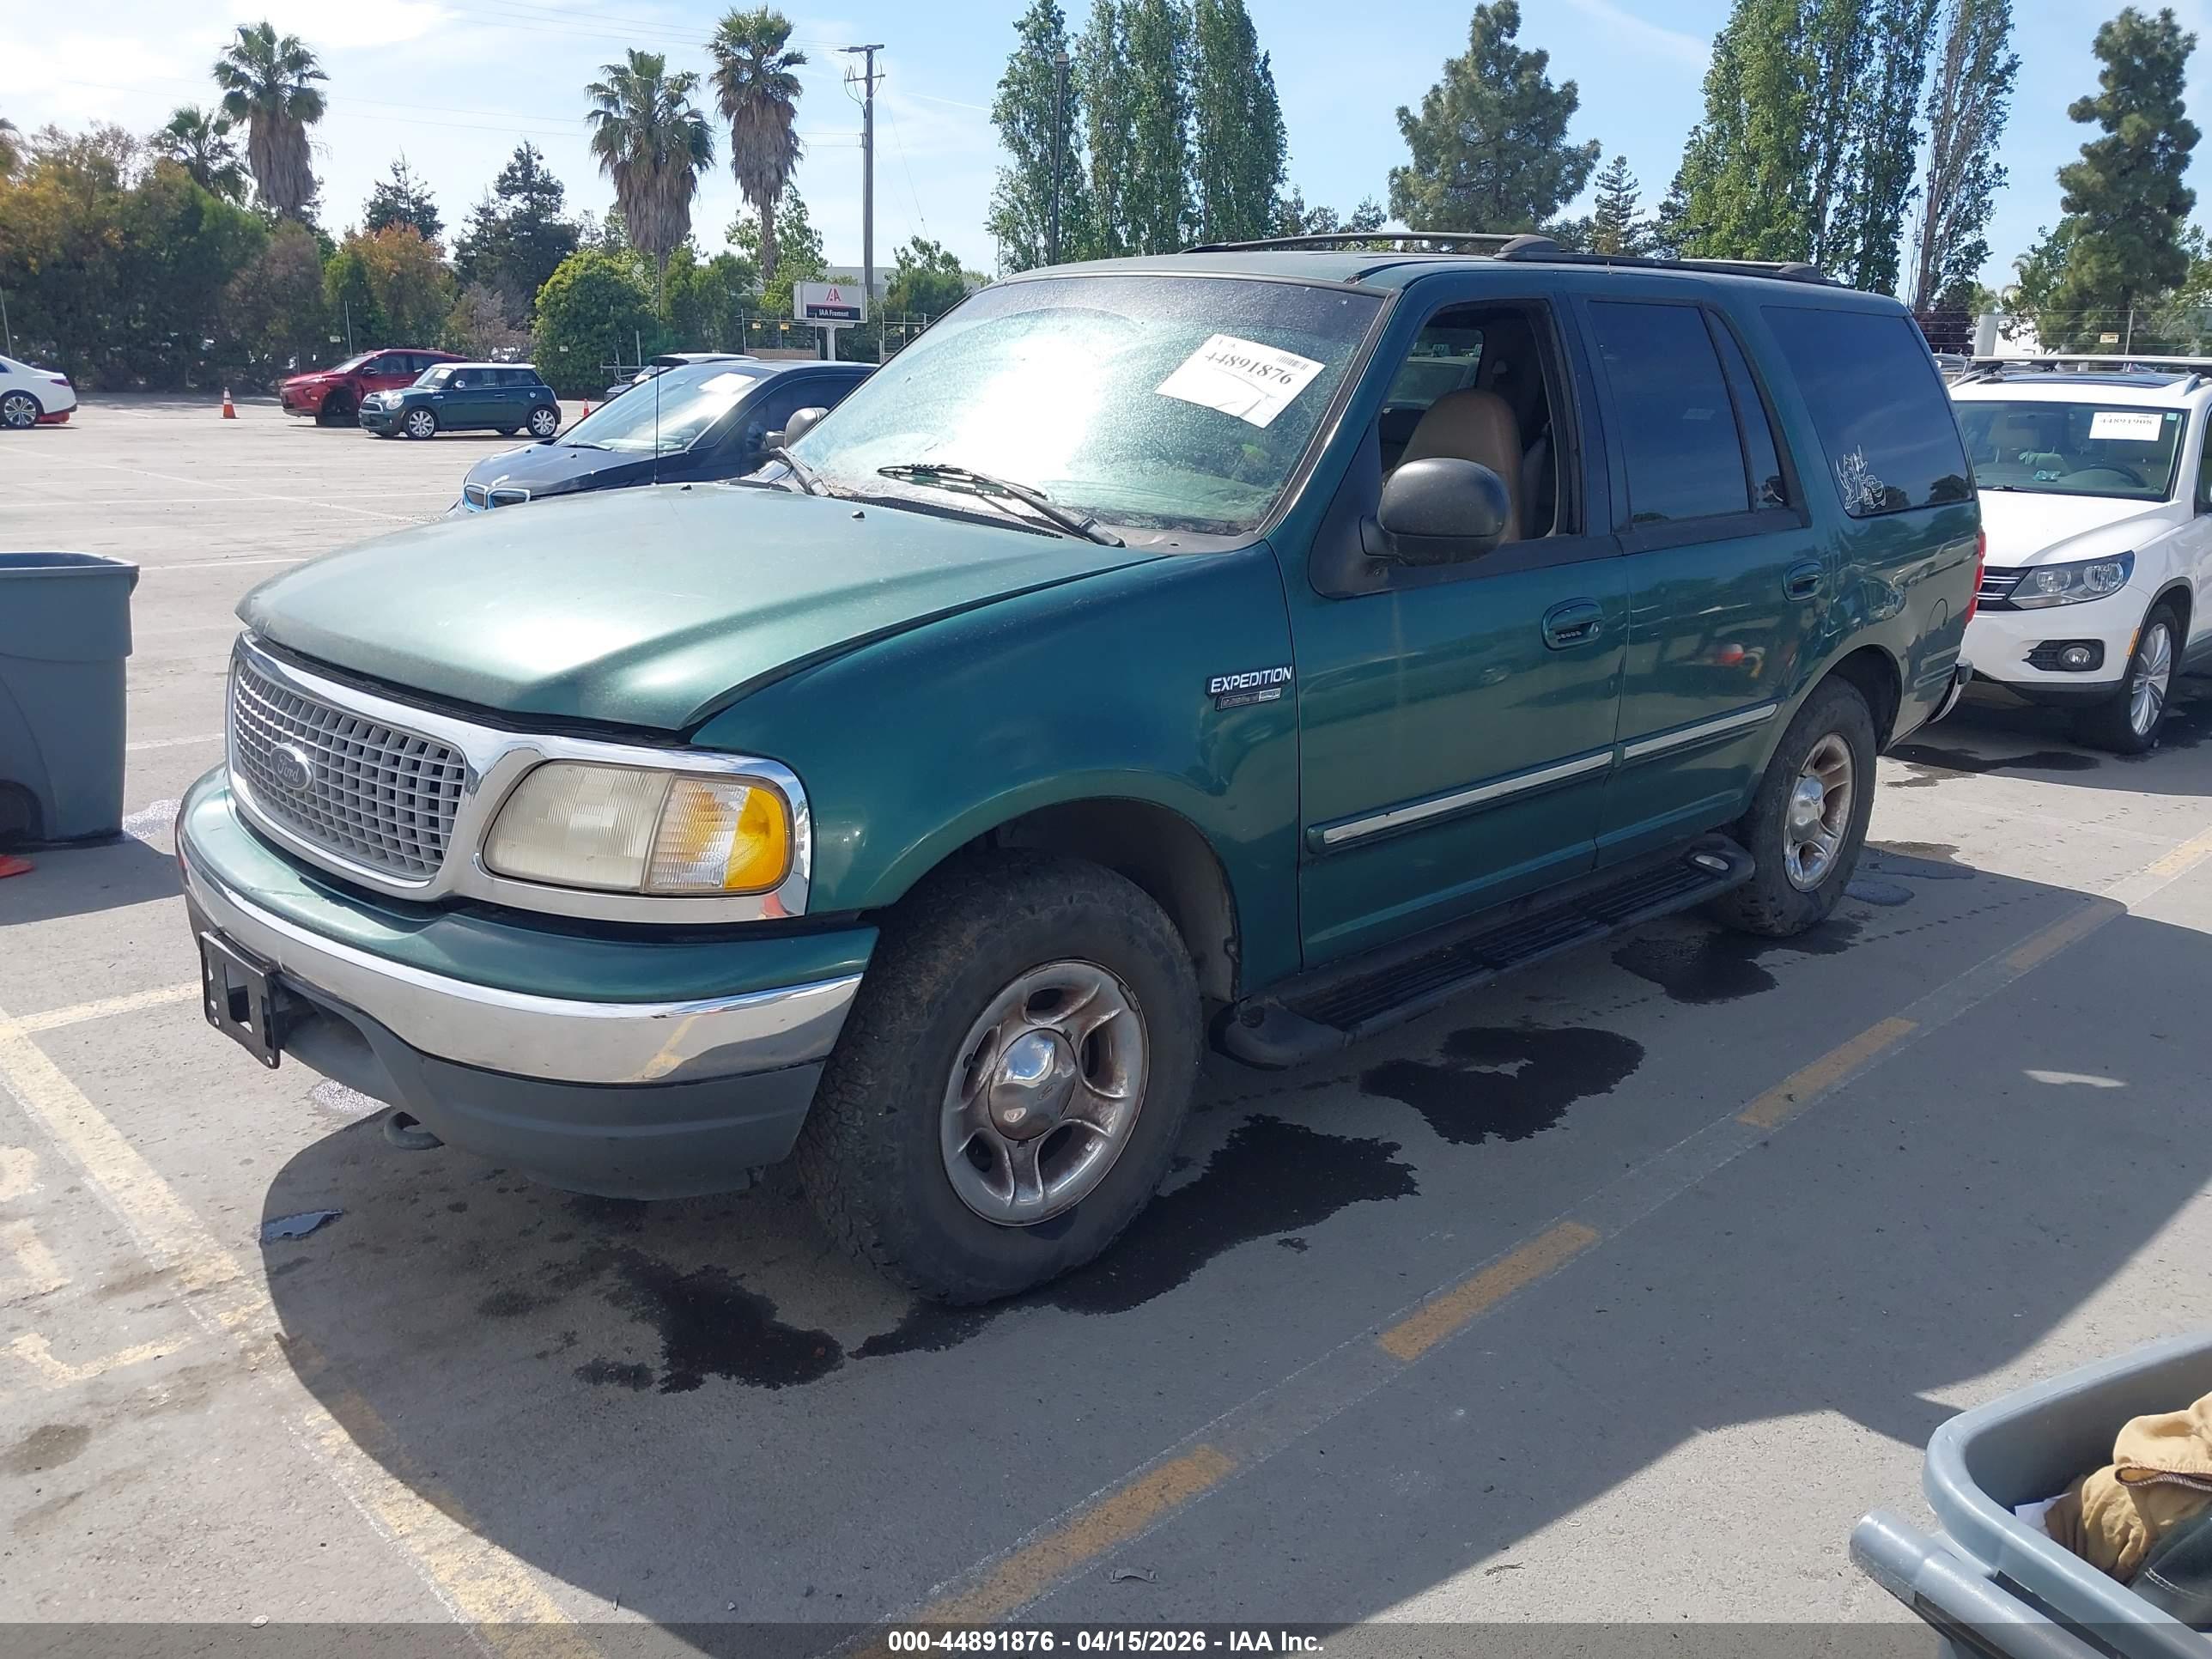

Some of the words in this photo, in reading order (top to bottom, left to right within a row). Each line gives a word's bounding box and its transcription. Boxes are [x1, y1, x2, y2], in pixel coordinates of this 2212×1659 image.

[1205, 351, 1297, 386] 44891876
[1211, 665, 1292, 693] EXPEDITION
[277, 753, 301, 783] Ford
